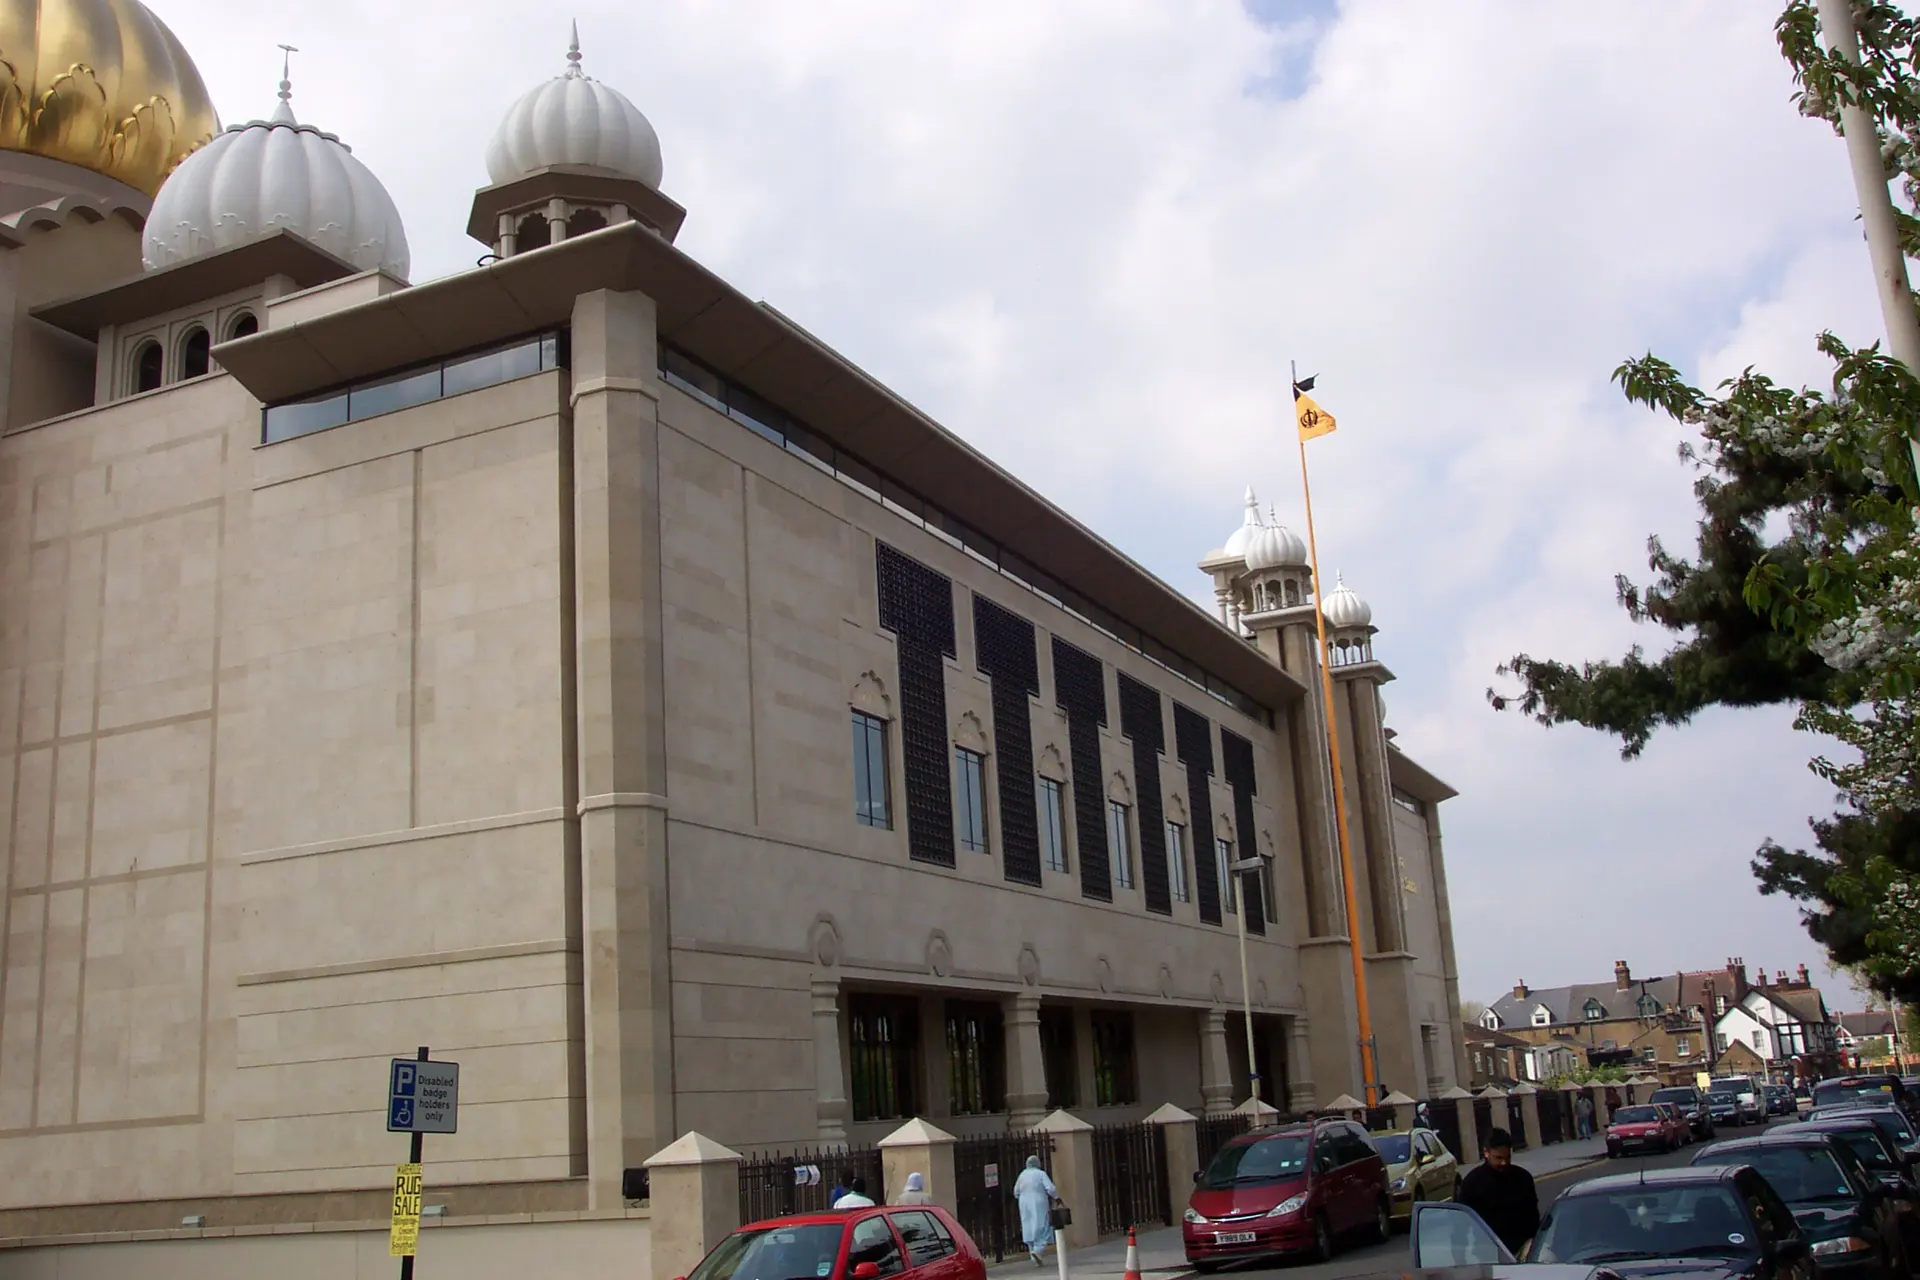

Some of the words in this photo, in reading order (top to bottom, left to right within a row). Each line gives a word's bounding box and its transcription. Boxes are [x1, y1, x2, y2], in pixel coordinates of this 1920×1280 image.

[398, 1067, 413, 1093] P
[418, 1074, 454, 1087] Disabled
[422, 1087, 448, 1100] badge
[418, 1099, 450, 1110] holders
[424, 1111, 444, 1123] only
[395, 1176, 422, 1195] RUG
[394, 1196, 420, 1216] SALE
